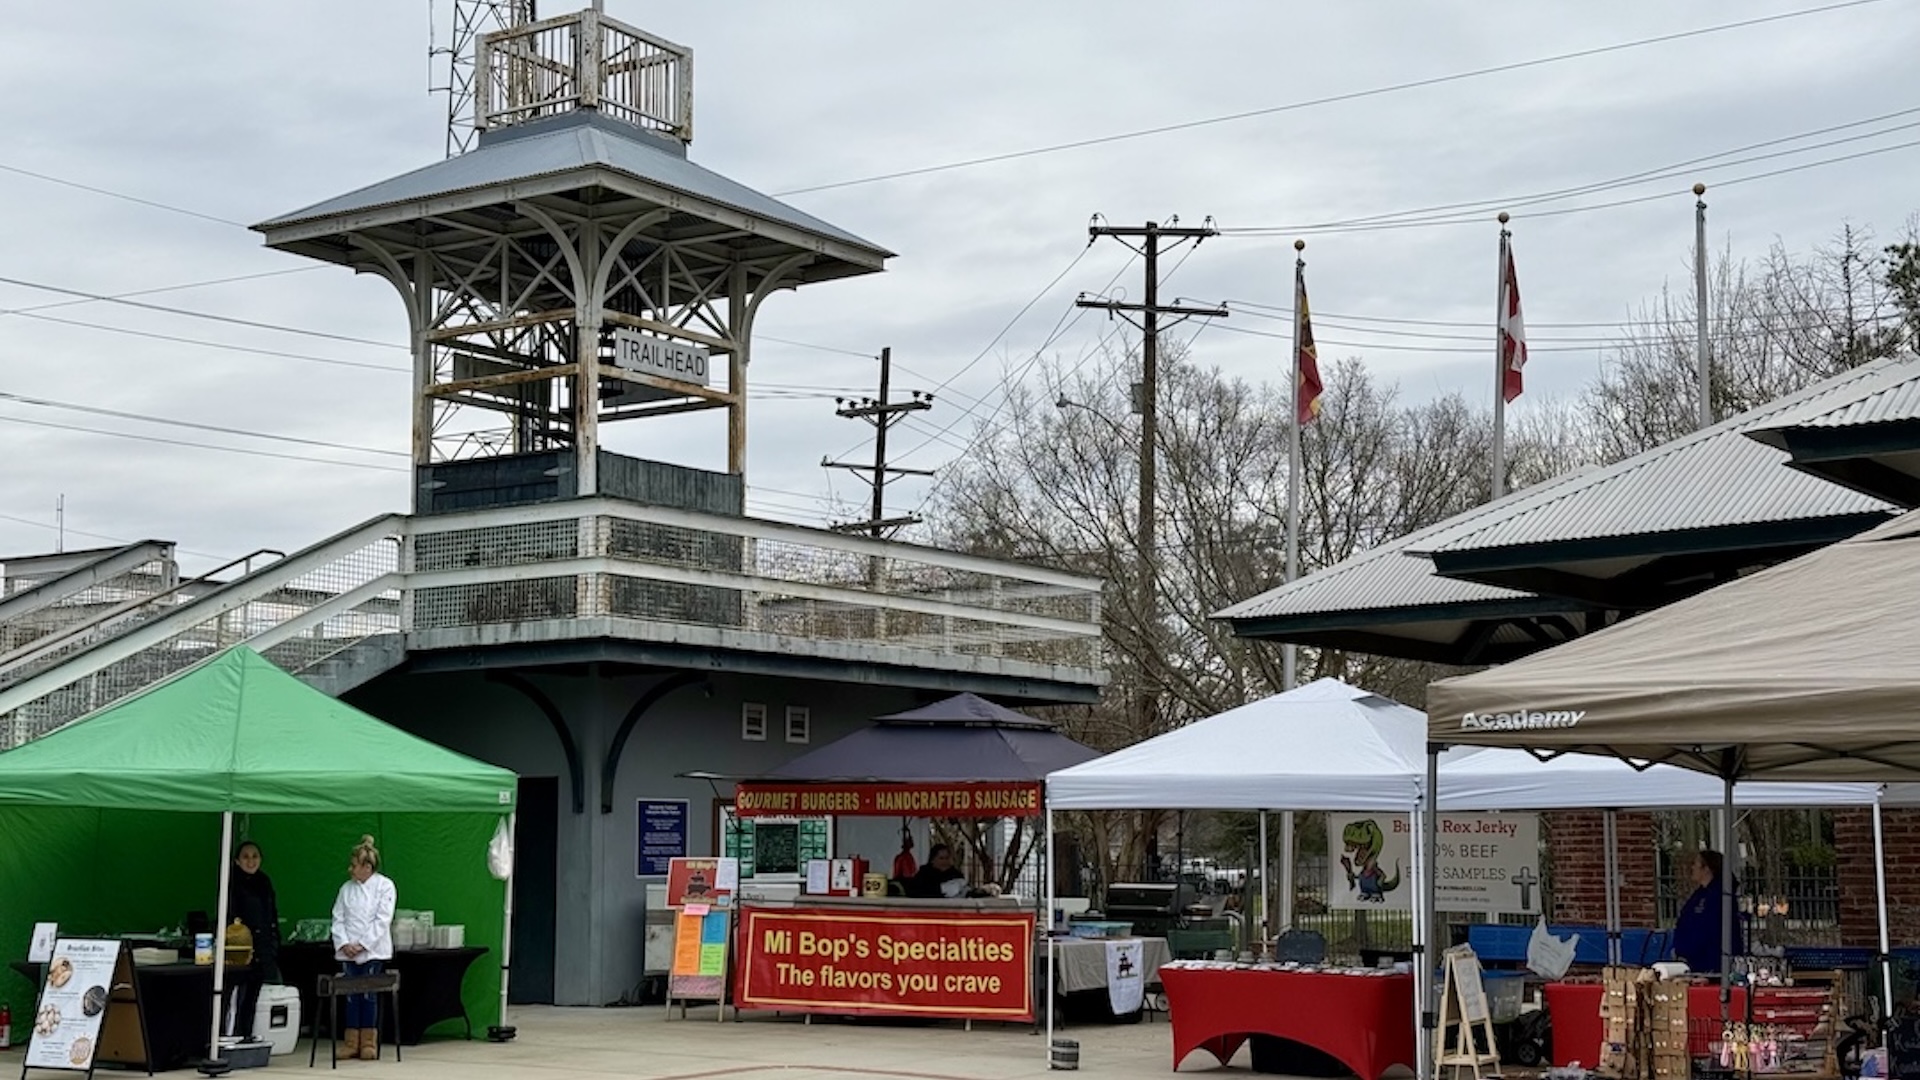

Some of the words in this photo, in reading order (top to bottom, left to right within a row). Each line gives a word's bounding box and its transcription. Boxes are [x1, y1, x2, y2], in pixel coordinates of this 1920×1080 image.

[621, 338, 705, 376] TRAILHEAD
[1461, 709, 1586, 728] Academy
[737, 791, 798, 811] GOURMET
[800, 792, 861, 811] BURGERS
[876, 790, 970, 811] HANDCRAFTED
[974, 789, 1036, 810] SAUSAGE
[1442, 820, 1472, 834] Rex
[1474, 819, 1518, 837] Jerky
[1459, 844, 1499, 859] BEEF
[1442, 866, 1507, 881] SAMPLES
[763, 929, 792, 955] Mi
[799, 931, 871, 962] Bop's
[877, 934, 1015, 966] Specialties
[776, 963, 815, 987] The
[820, 964, 893, 990] flavors
[897, 973, 939, 997] you
[944, 974, 1001, 994] crave
